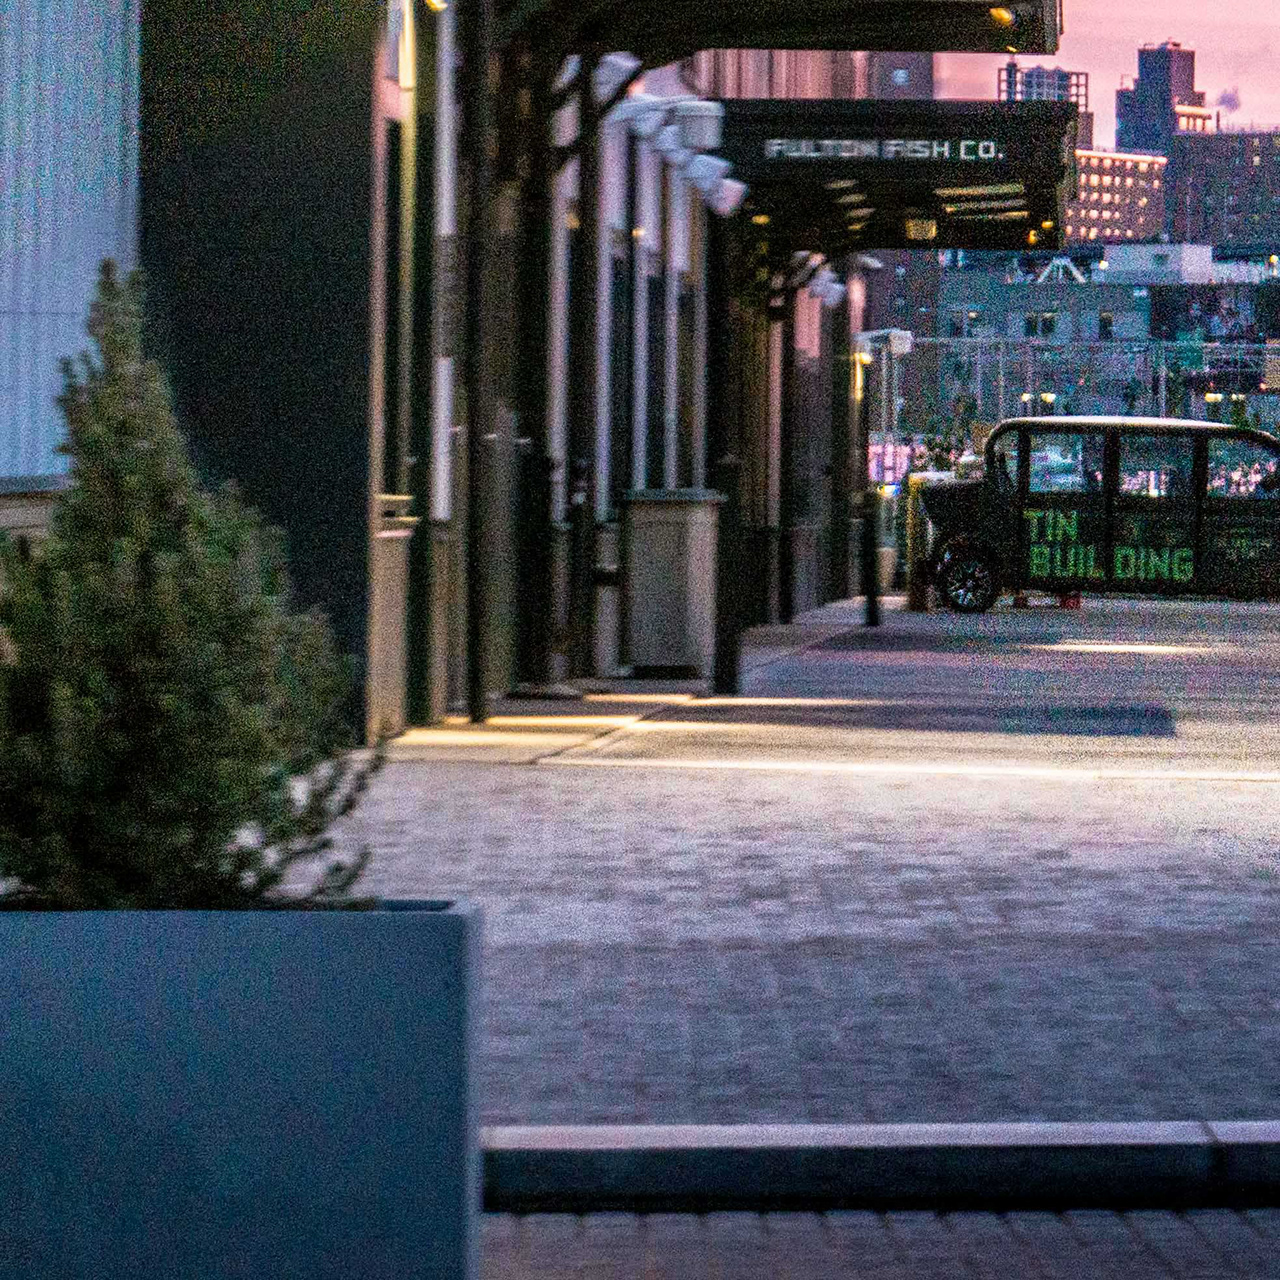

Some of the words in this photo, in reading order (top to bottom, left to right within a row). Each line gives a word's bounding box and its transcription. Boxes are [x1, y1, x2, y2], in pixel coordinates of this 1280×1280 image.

[765, 138, 879, 160] FULTON
[882, 139, 950, 160] FISH
[959, 140, 1005, 160] CO.
[1023, 509, 1079, 542] TIN
[1029, 545, 1195, 583] BUILDING
